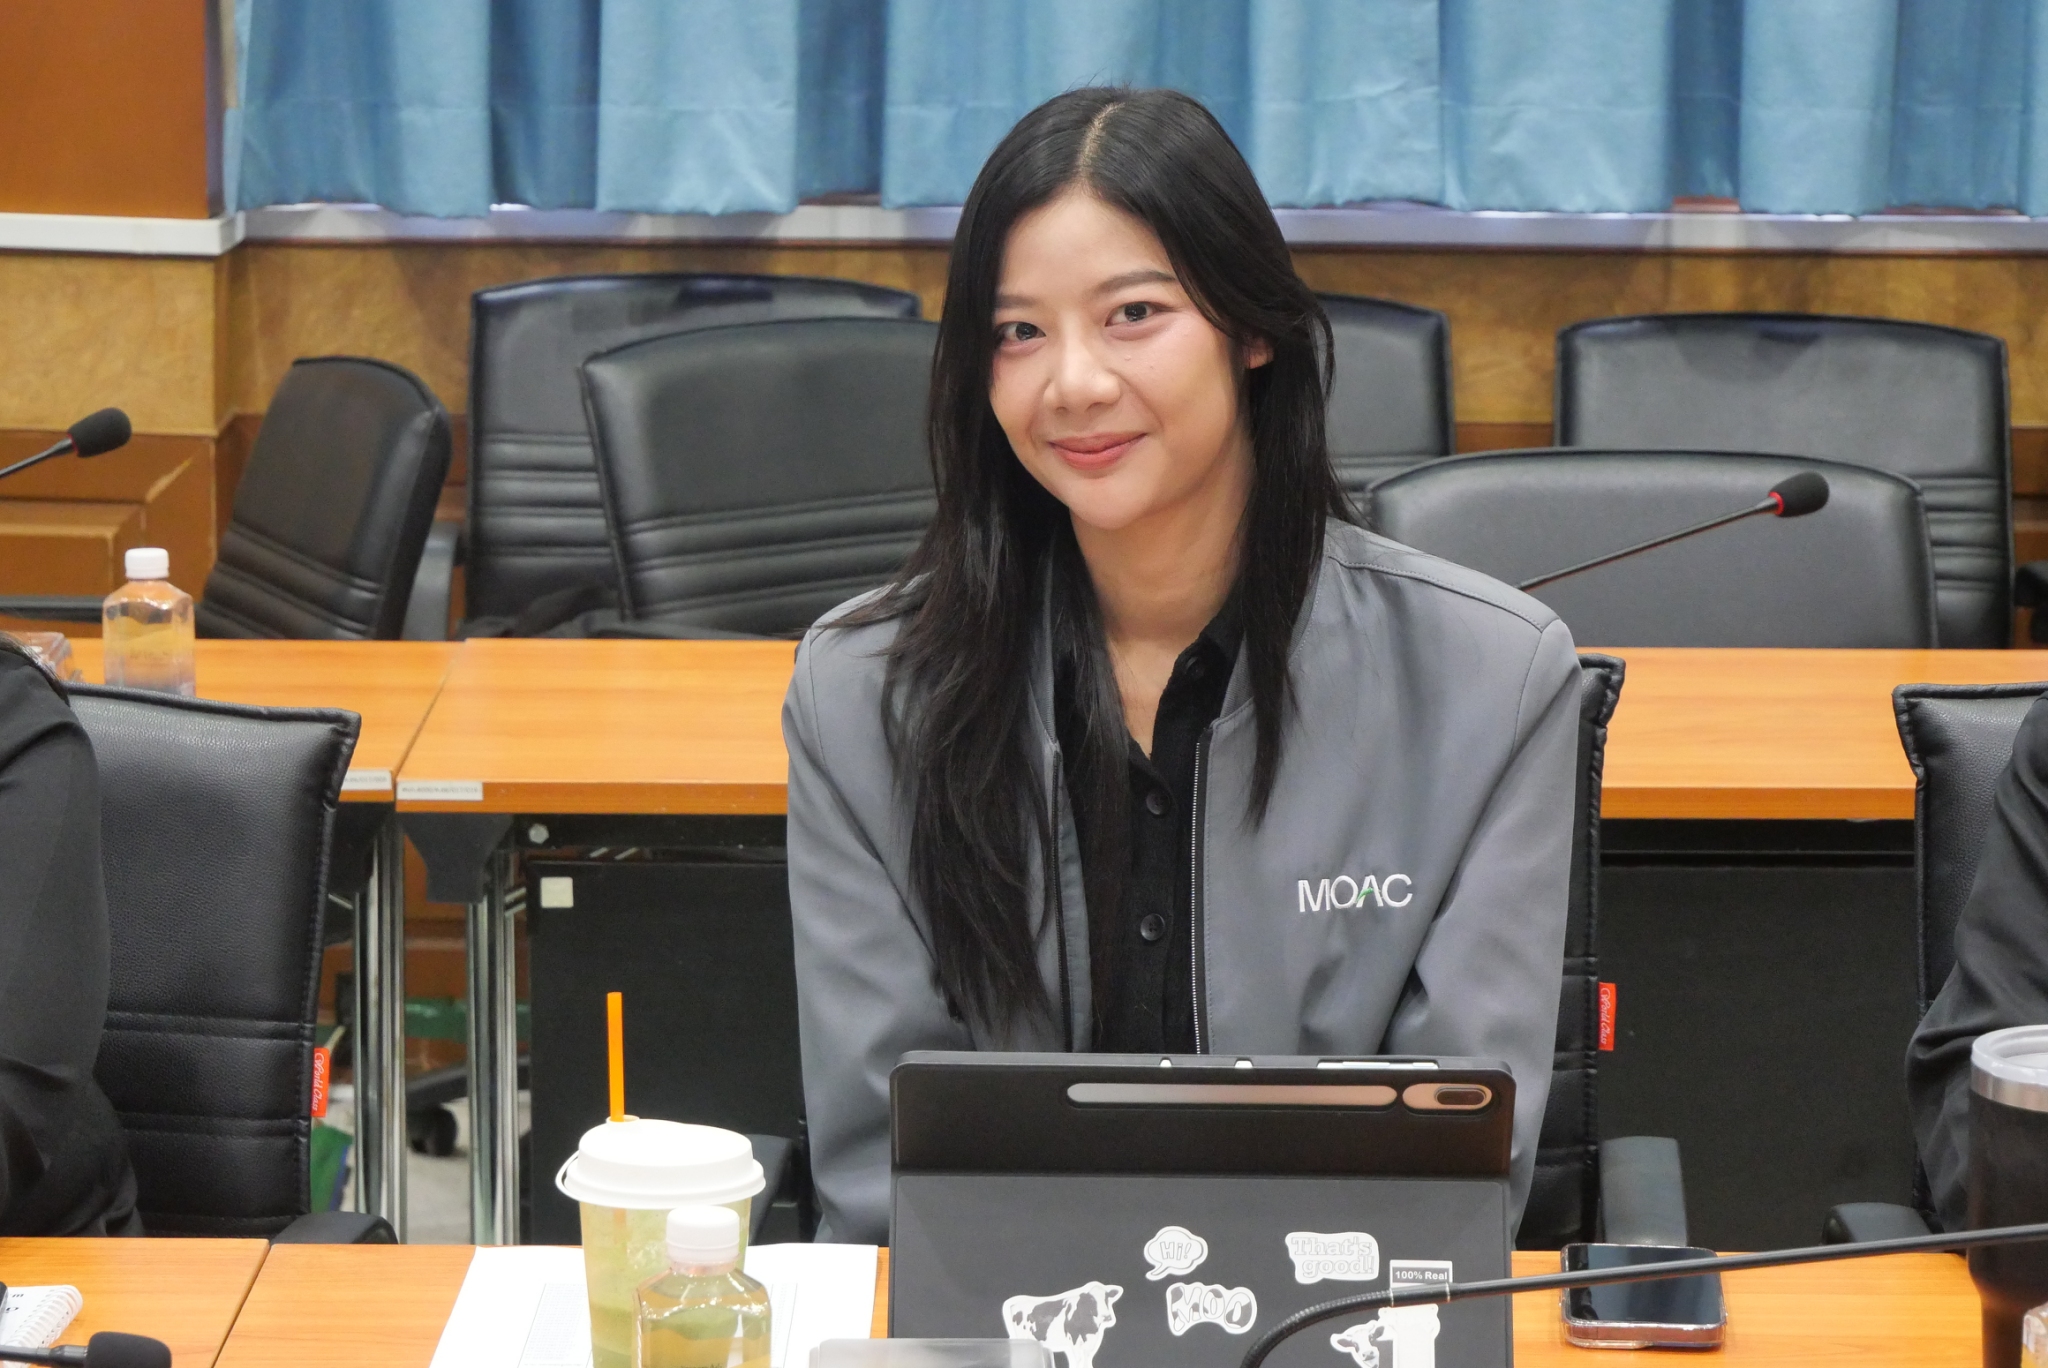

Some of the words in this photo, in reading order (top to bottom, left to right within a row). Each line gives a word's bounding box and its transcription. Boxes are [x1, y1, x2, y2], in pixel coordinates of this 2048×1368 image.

[1298, 873, 1413, 912] MOAC
[1600, 987, 1611, 1023] World
[313, 1052, 325, 1088] World
[312, 1088, 322, 1111] Class
[1160, 1241, 1192, 1260] Hi!
[1291, 1236, 1373, 1256] That's
[1302, 1256, 1375, 1278] good!
[1395, 1270, 1422, 1280] 100%
[1424, 1270, 1448, 1280] Real
